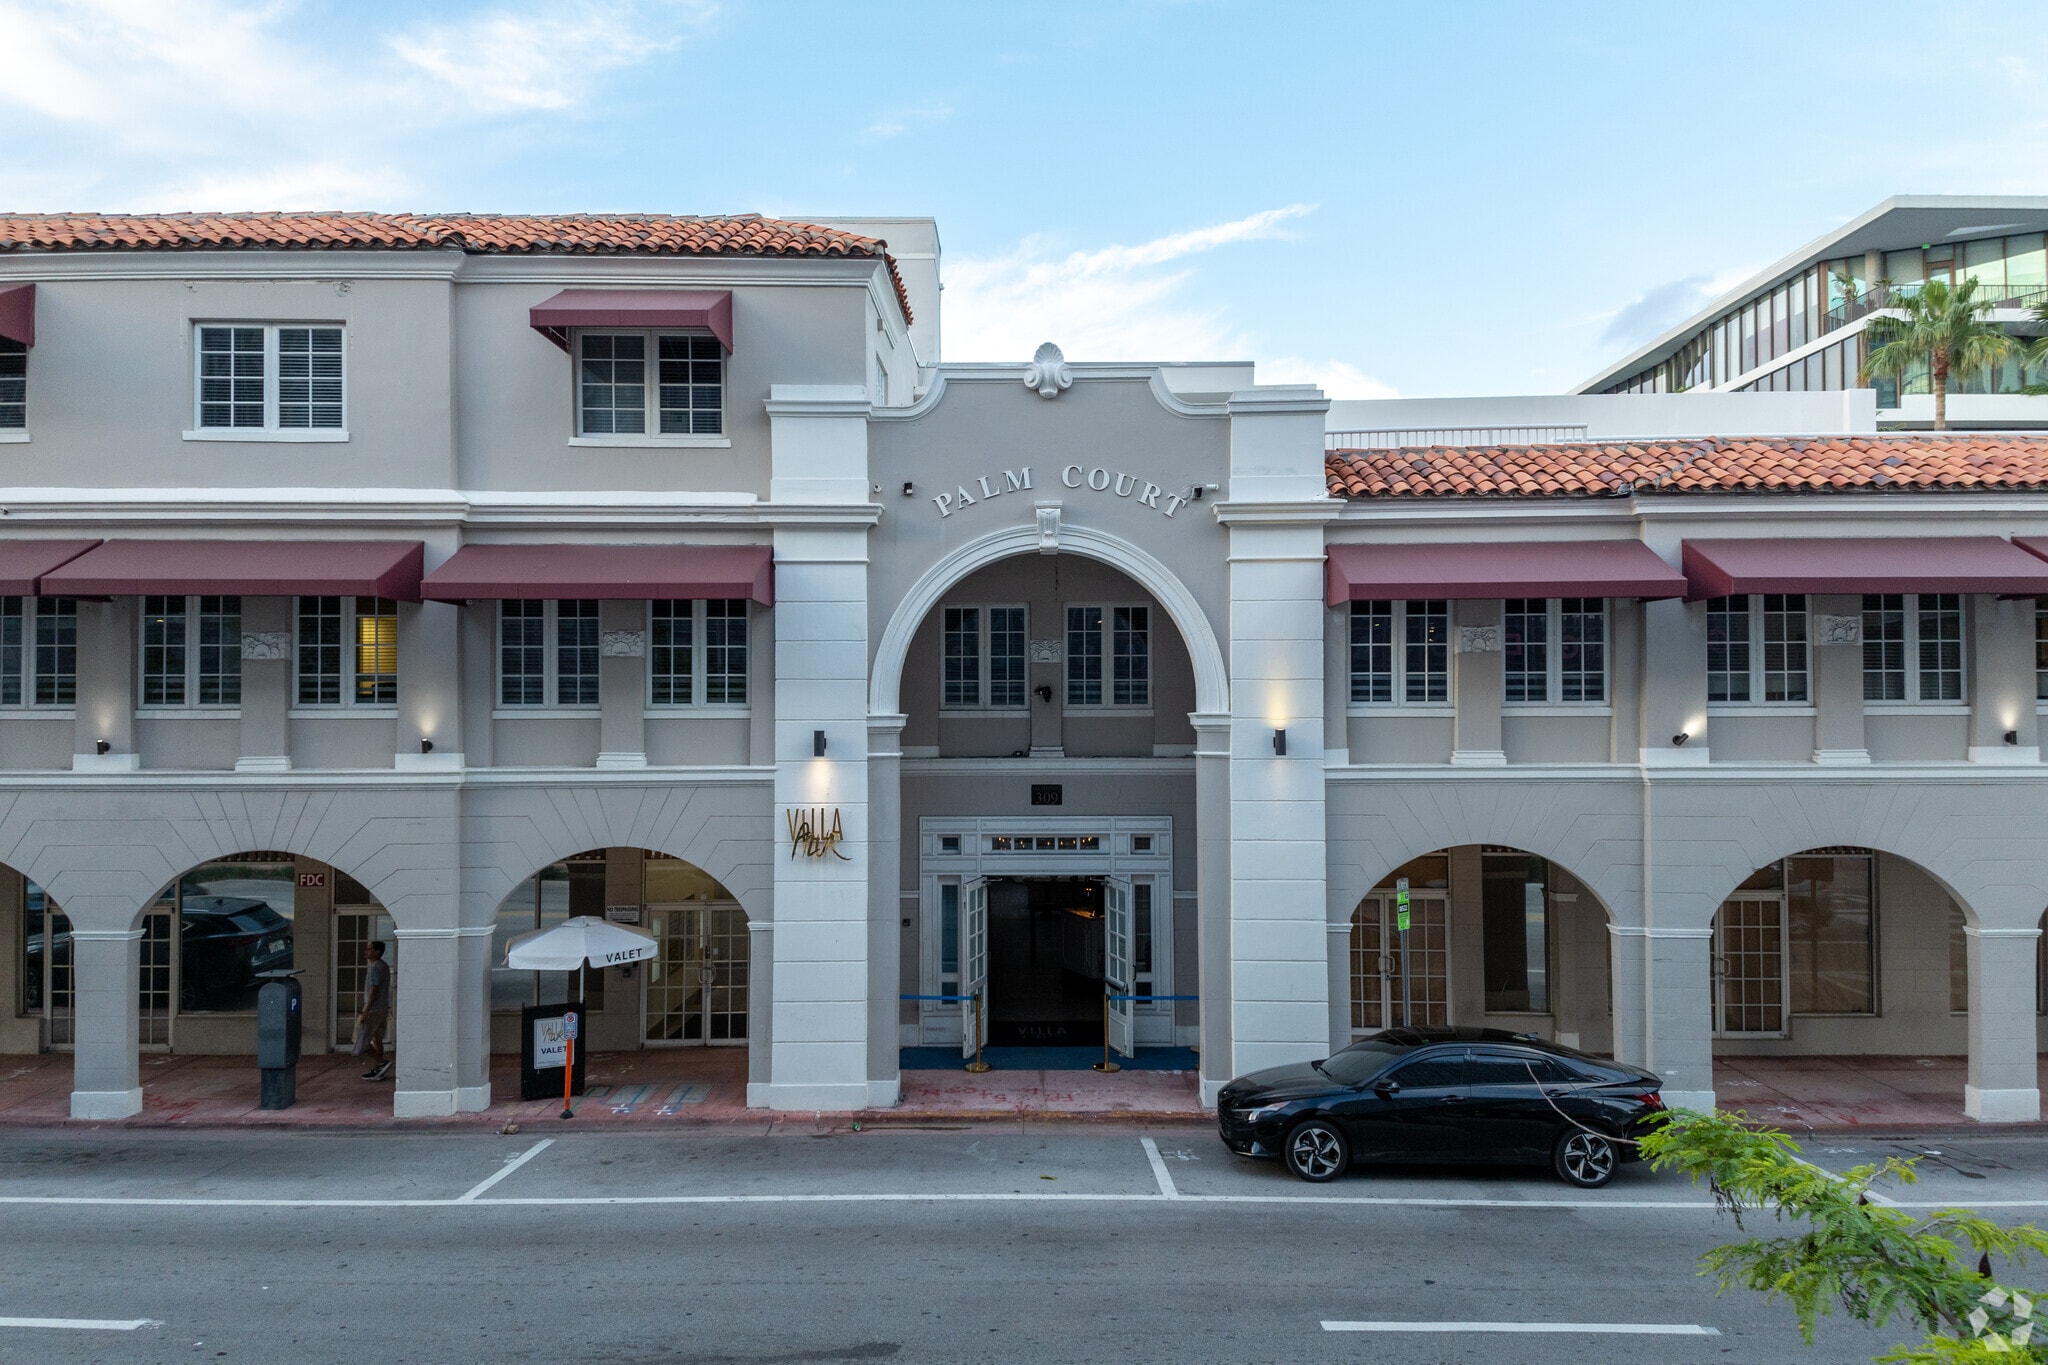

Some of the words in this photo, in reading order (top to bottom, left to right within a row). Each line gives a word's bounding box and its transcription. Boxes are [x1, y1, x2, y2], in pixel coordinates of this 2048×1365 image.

[933, 466, 1033, 518] PALM
[1062, 464, 1187, 518] COURT
[1035, 791, 1059, 804] 309
[786, 807, 844, 842] VILLA
[300, 874, 323, 886] FDC
[606, 948, 642, 963] VALET
[291, 998, 297, 1010] P
